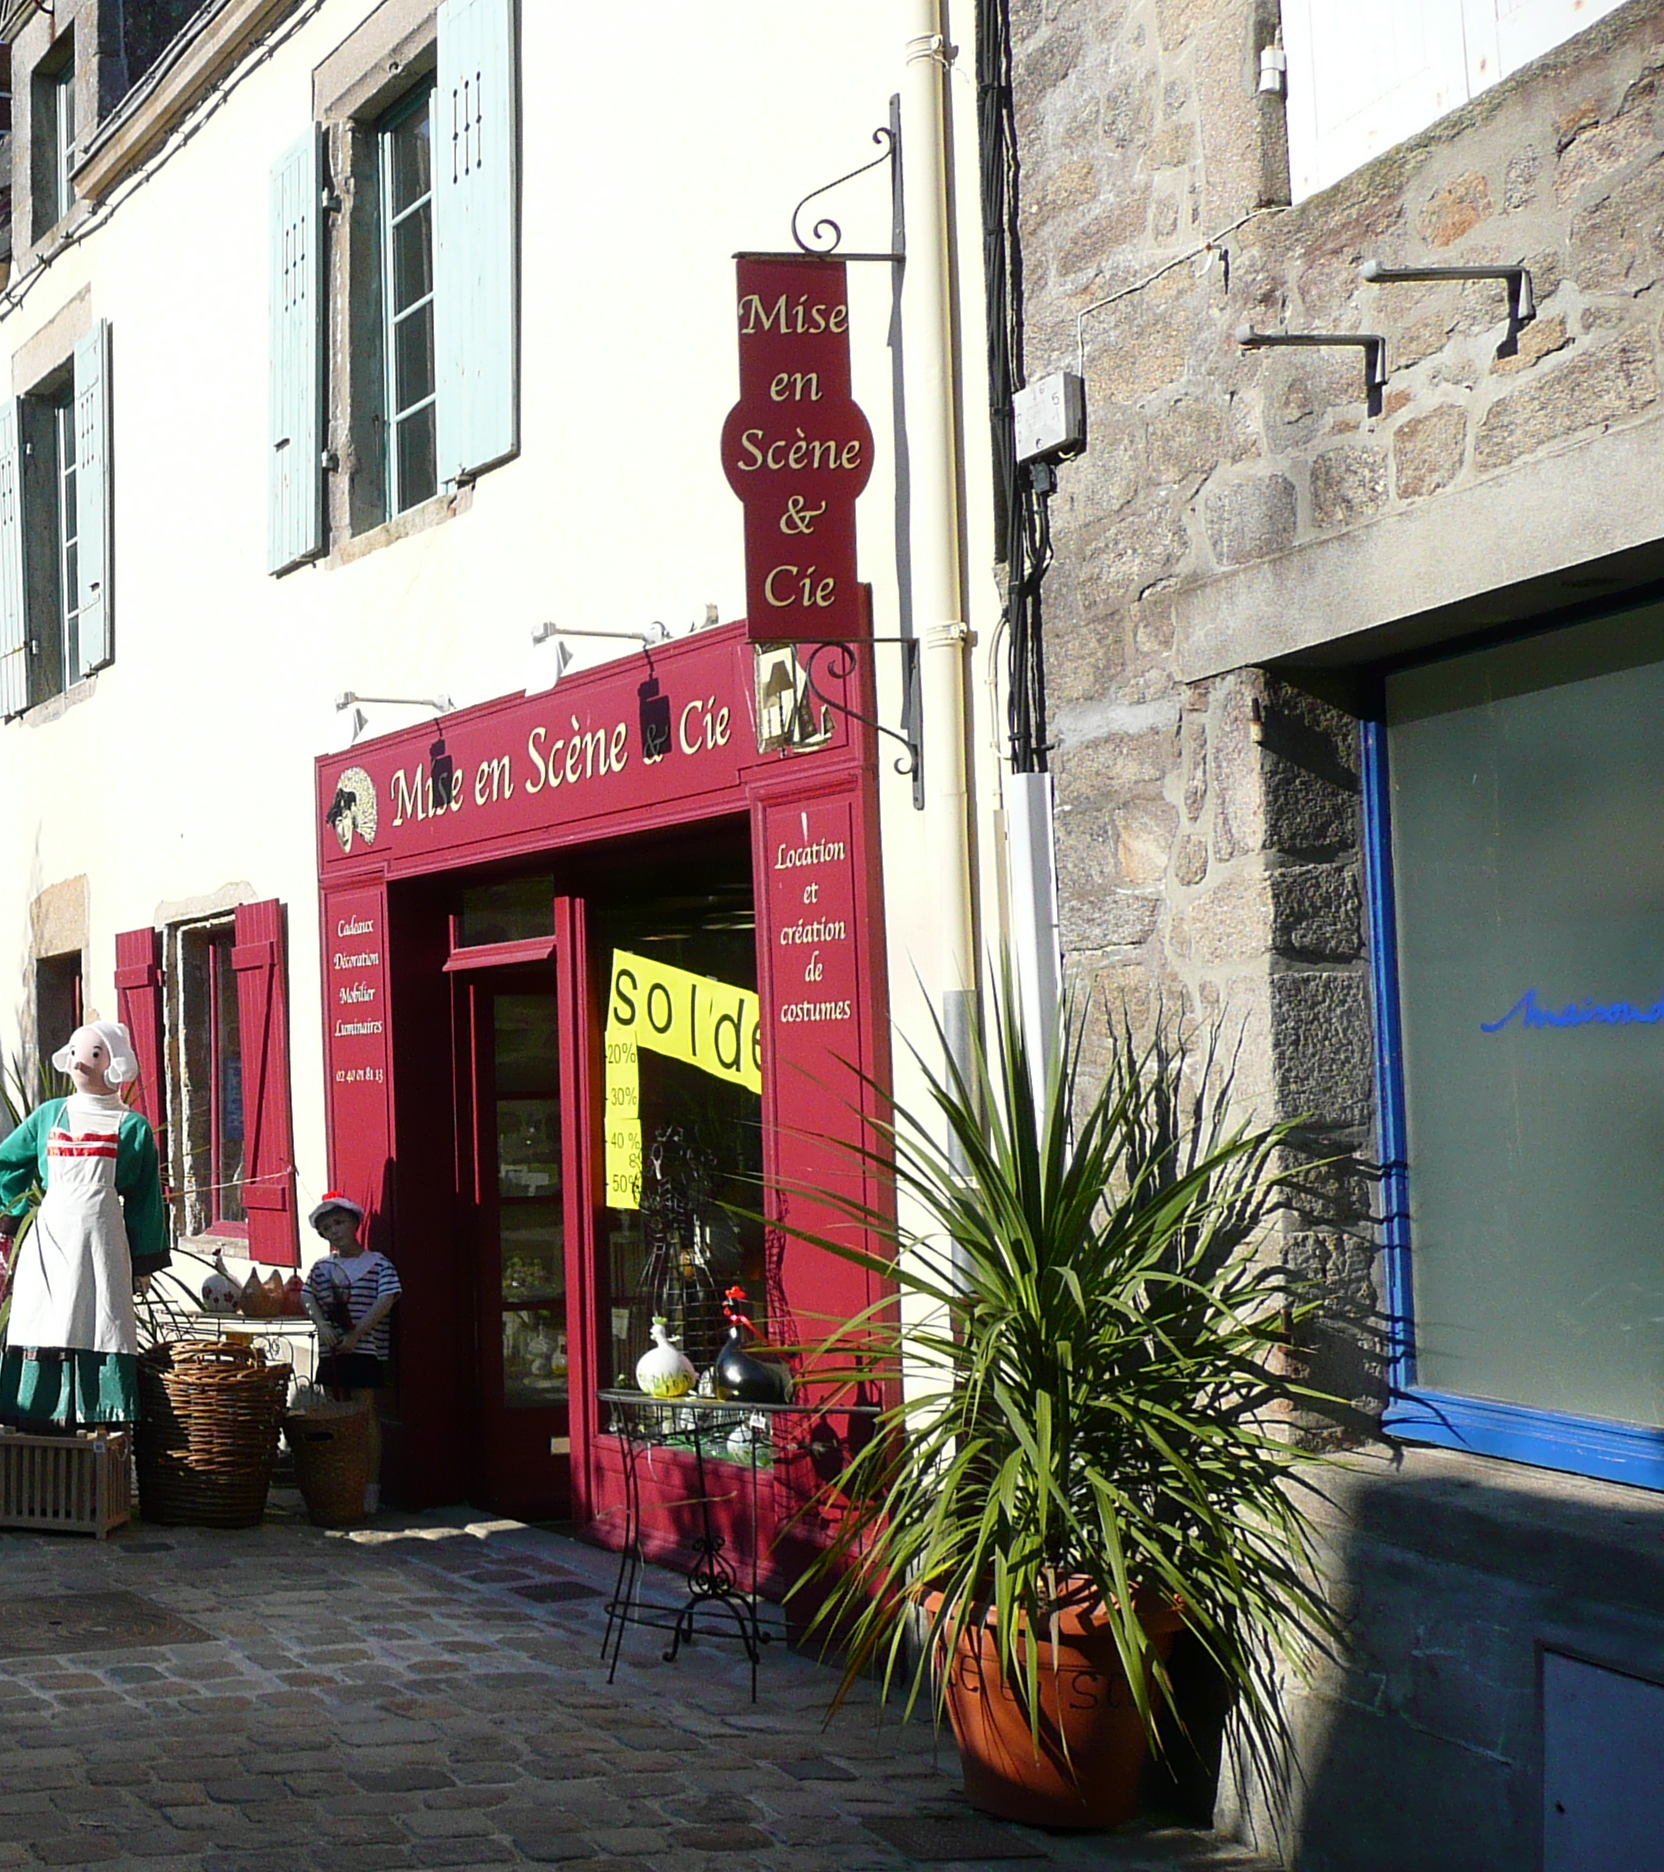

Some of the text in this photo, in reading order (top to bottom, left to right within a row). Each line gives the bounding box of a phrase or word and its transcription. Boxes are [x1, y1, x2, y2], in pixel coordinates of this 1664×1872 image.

[738, 294, 848, 334] Mise
[770, 372, 823, 401] en
[738, 427, 862, 471] Scène
[780, 496, 827, 534] &
[765, 565, 835, 607] Cie
[390, 695, 730, 827] Mise en Scène & Cie
[774, 838, 845, 869] Location
[803, 882, 818, 904] et
[338, 915, 373, 937] Cadeaux
[780, 917, 846, 945] création
[334, 951, 379, 969] Décoration
[804, 951, 823, 982] de
[340, 981, 375, 1004] Mobilier
[781, 1000, 851, 1022] costumes
[335, 1018, 382, 1037] Luminaires
[608, 1042, 637, 1064] 20%
[611, 1087, 638, 1106] 30%
